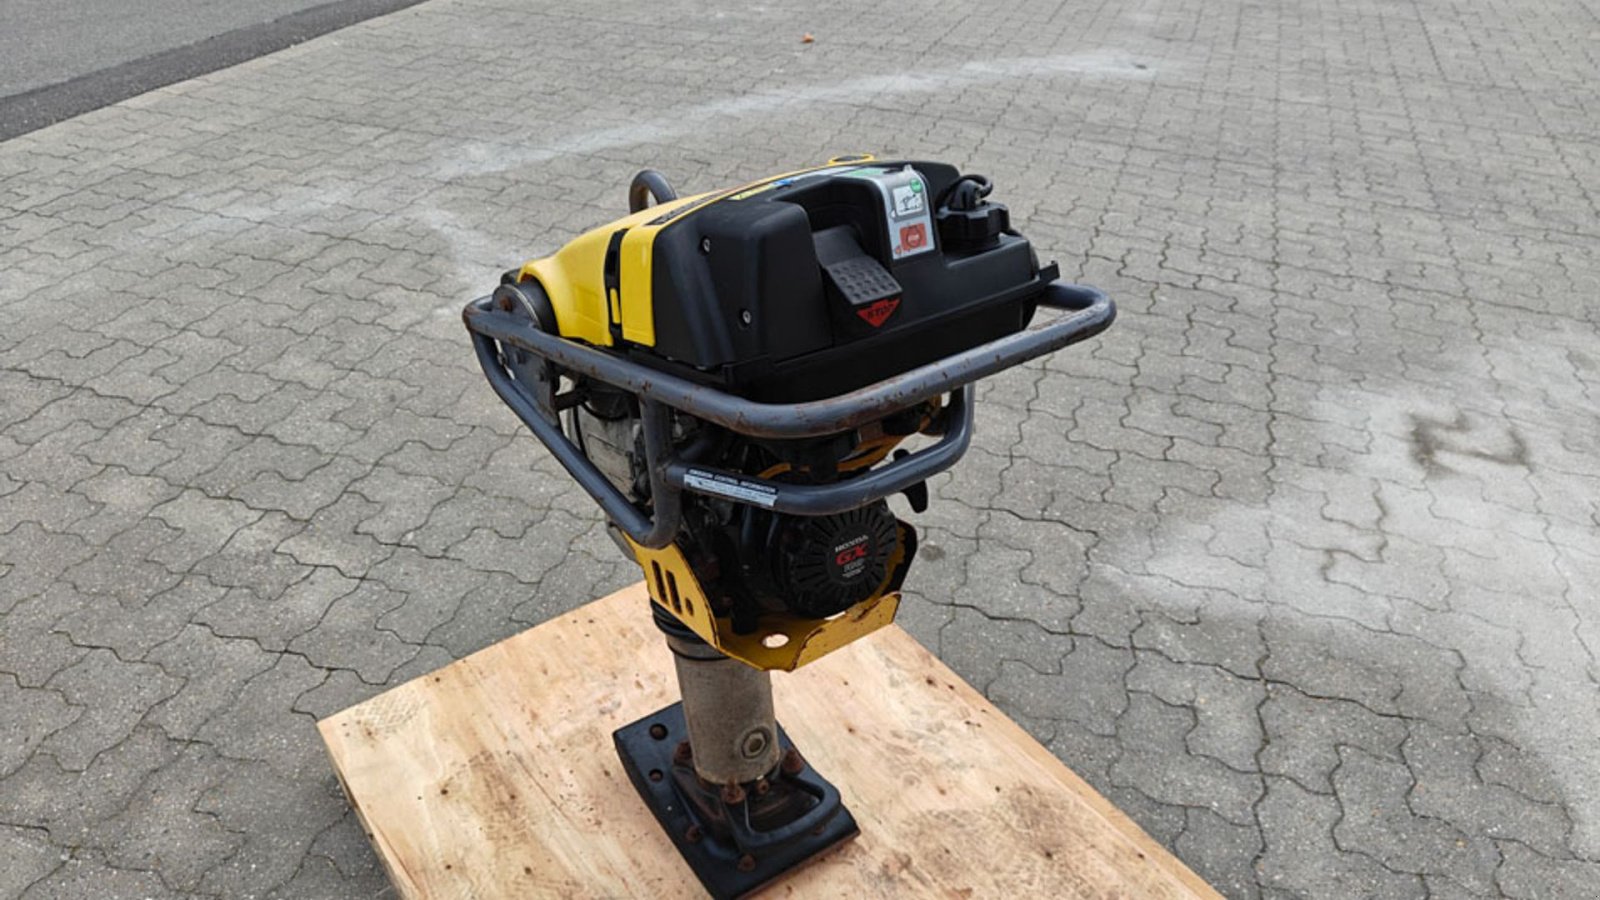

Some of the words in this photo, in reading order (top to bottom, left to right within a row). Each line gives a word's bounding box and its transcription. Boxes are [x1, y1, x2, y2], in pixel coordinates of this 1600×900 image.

[713, 474, 738, 485] CONTROL
[740, 480, 776, 493] INFORMATION
[834, 534, 869, 553] HONDA
[835, 544, 869, 566] GX
